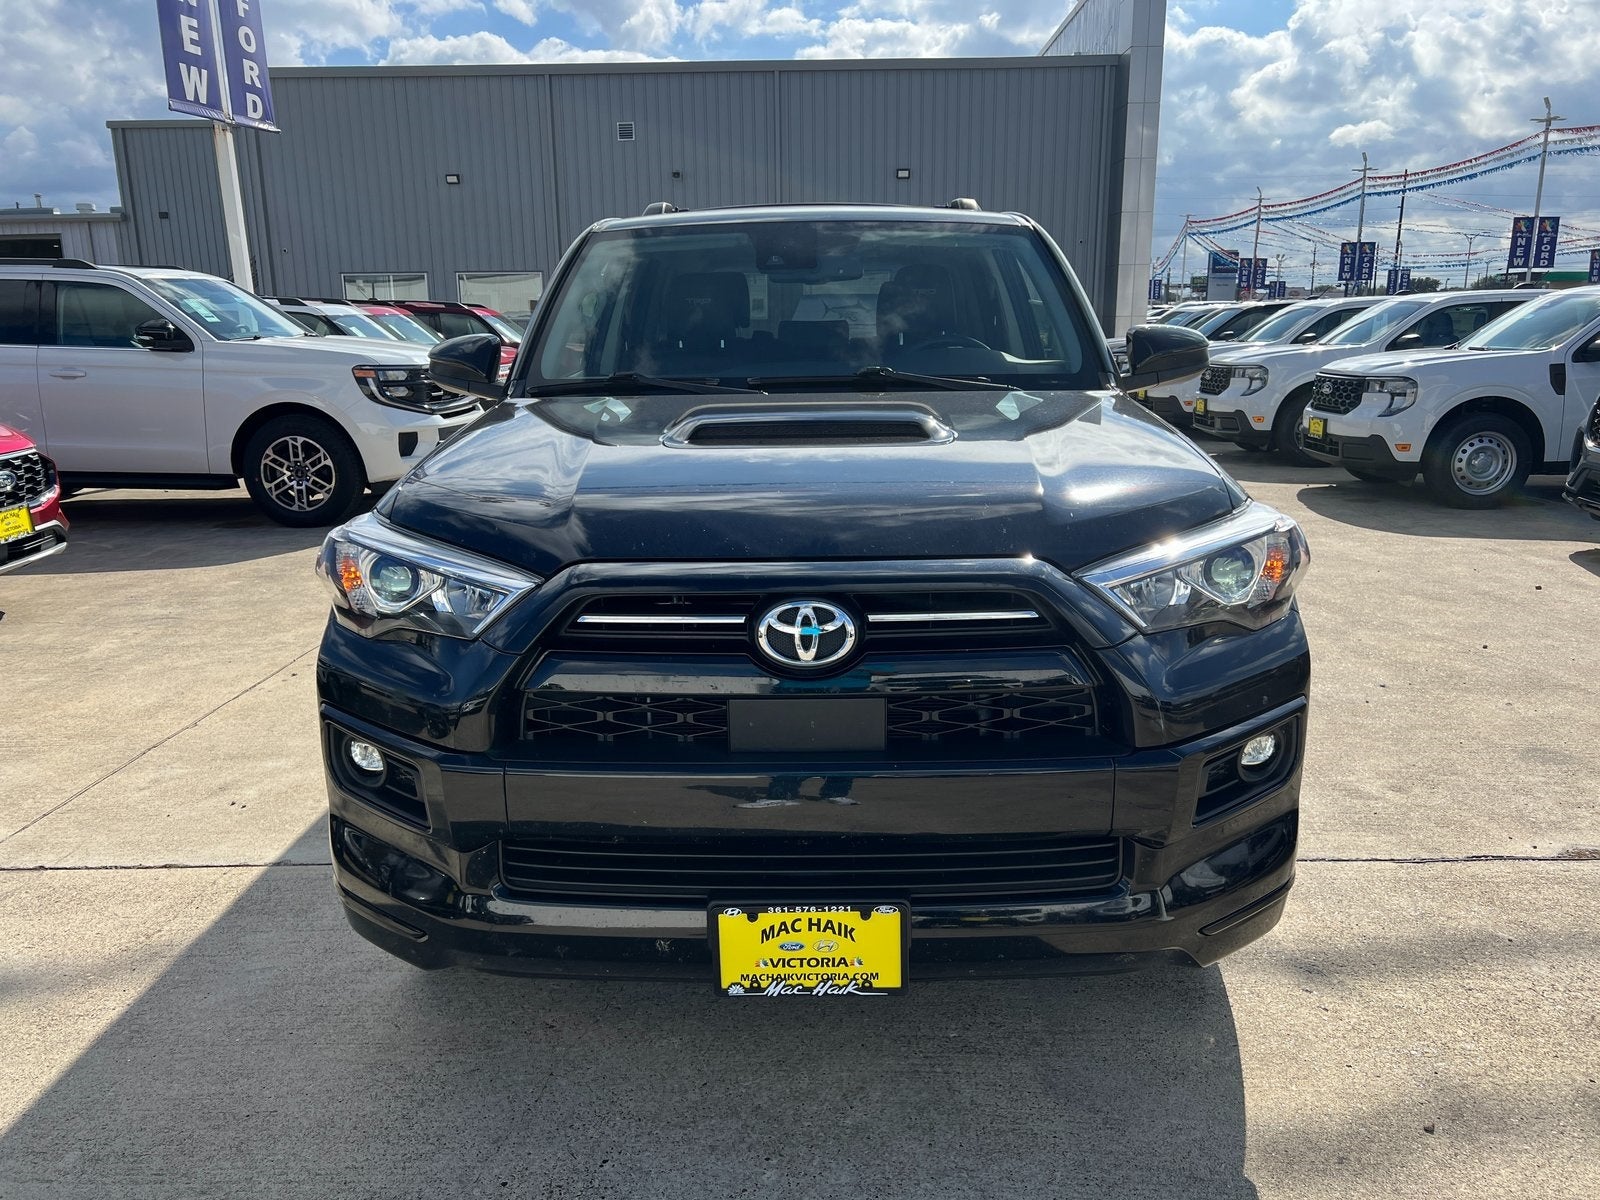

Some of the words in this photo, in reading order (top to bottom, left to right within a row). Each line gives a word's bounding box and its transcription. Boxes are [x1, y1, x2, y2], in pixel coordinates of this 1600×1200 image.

[178, 0, 208, 104] EW
[236, 0, 263, 119] FORD
[1513, 238, 1526, 266] NEW
[1540, 237, 1551, 266] FORD
[1342, 257, 1351, 279] NEW
[1362, 257, 1370, 279] FORD
[761, 918, 802, 944] MAC
[808, 918, 856, 943] HAIK
[769, 957, 849, 968] VICTORIA
[740, 972, 879, 982] MACHAIKVICTORIA.COM
[764, 980, 811, 996] Mac
[812, 980, 860, 996] Haik
